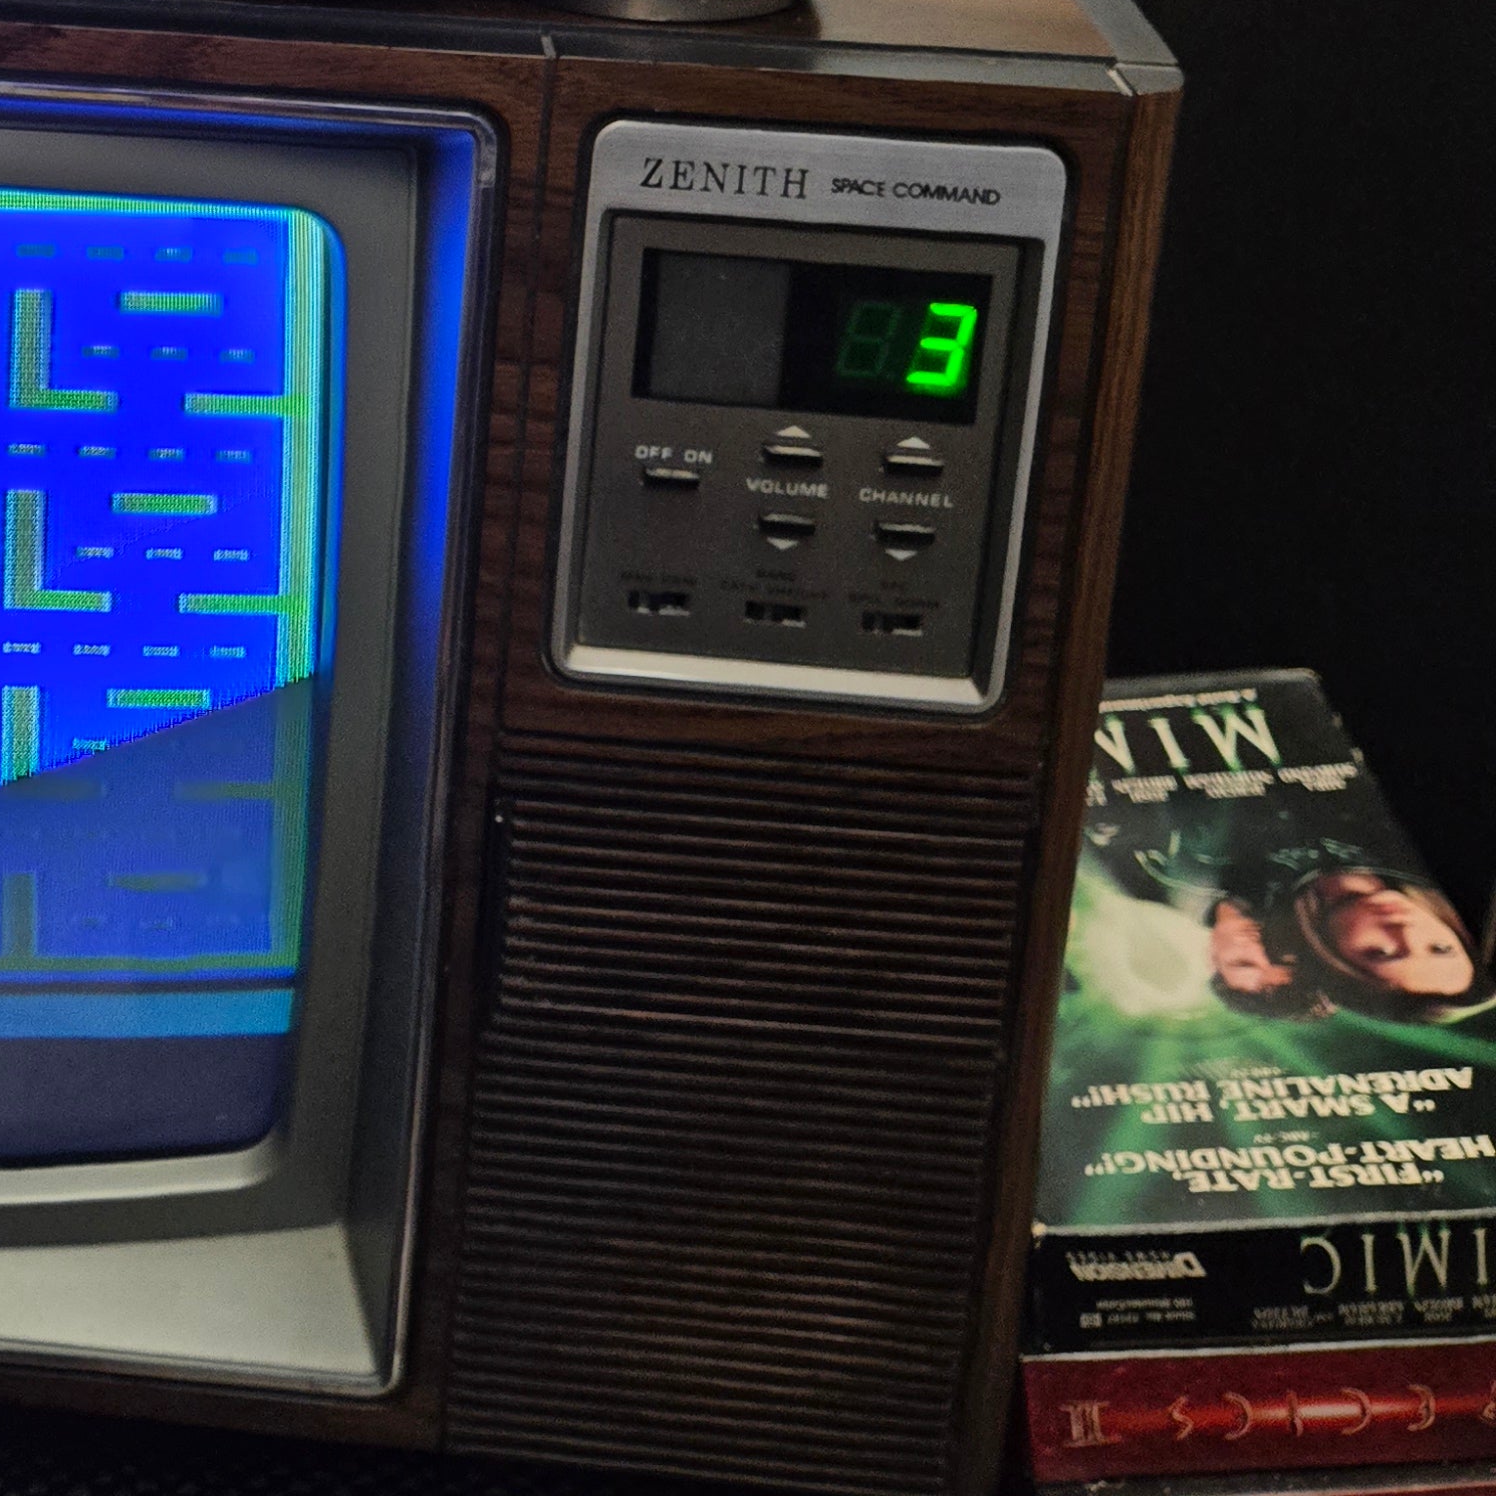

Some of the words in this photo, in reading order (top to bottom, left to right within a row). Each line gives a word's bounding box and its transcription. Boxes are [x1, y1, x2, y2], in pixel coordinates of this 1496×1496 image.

[639, 157, 810, 201] ZENITH
[831, 177, 886, 198] SPACE
[893, 182, 1001, 206] COMMAND
[906, 302, 978, 387] 3
[634, 444, 673, 463] OFF
[683, 447, 713, 465] ON
[745, 477, 830, 500] VOLUME
[859, 487, 954, 509] CHANNEL
[1217, 1065, 1474, 1104] ADRENALINE
